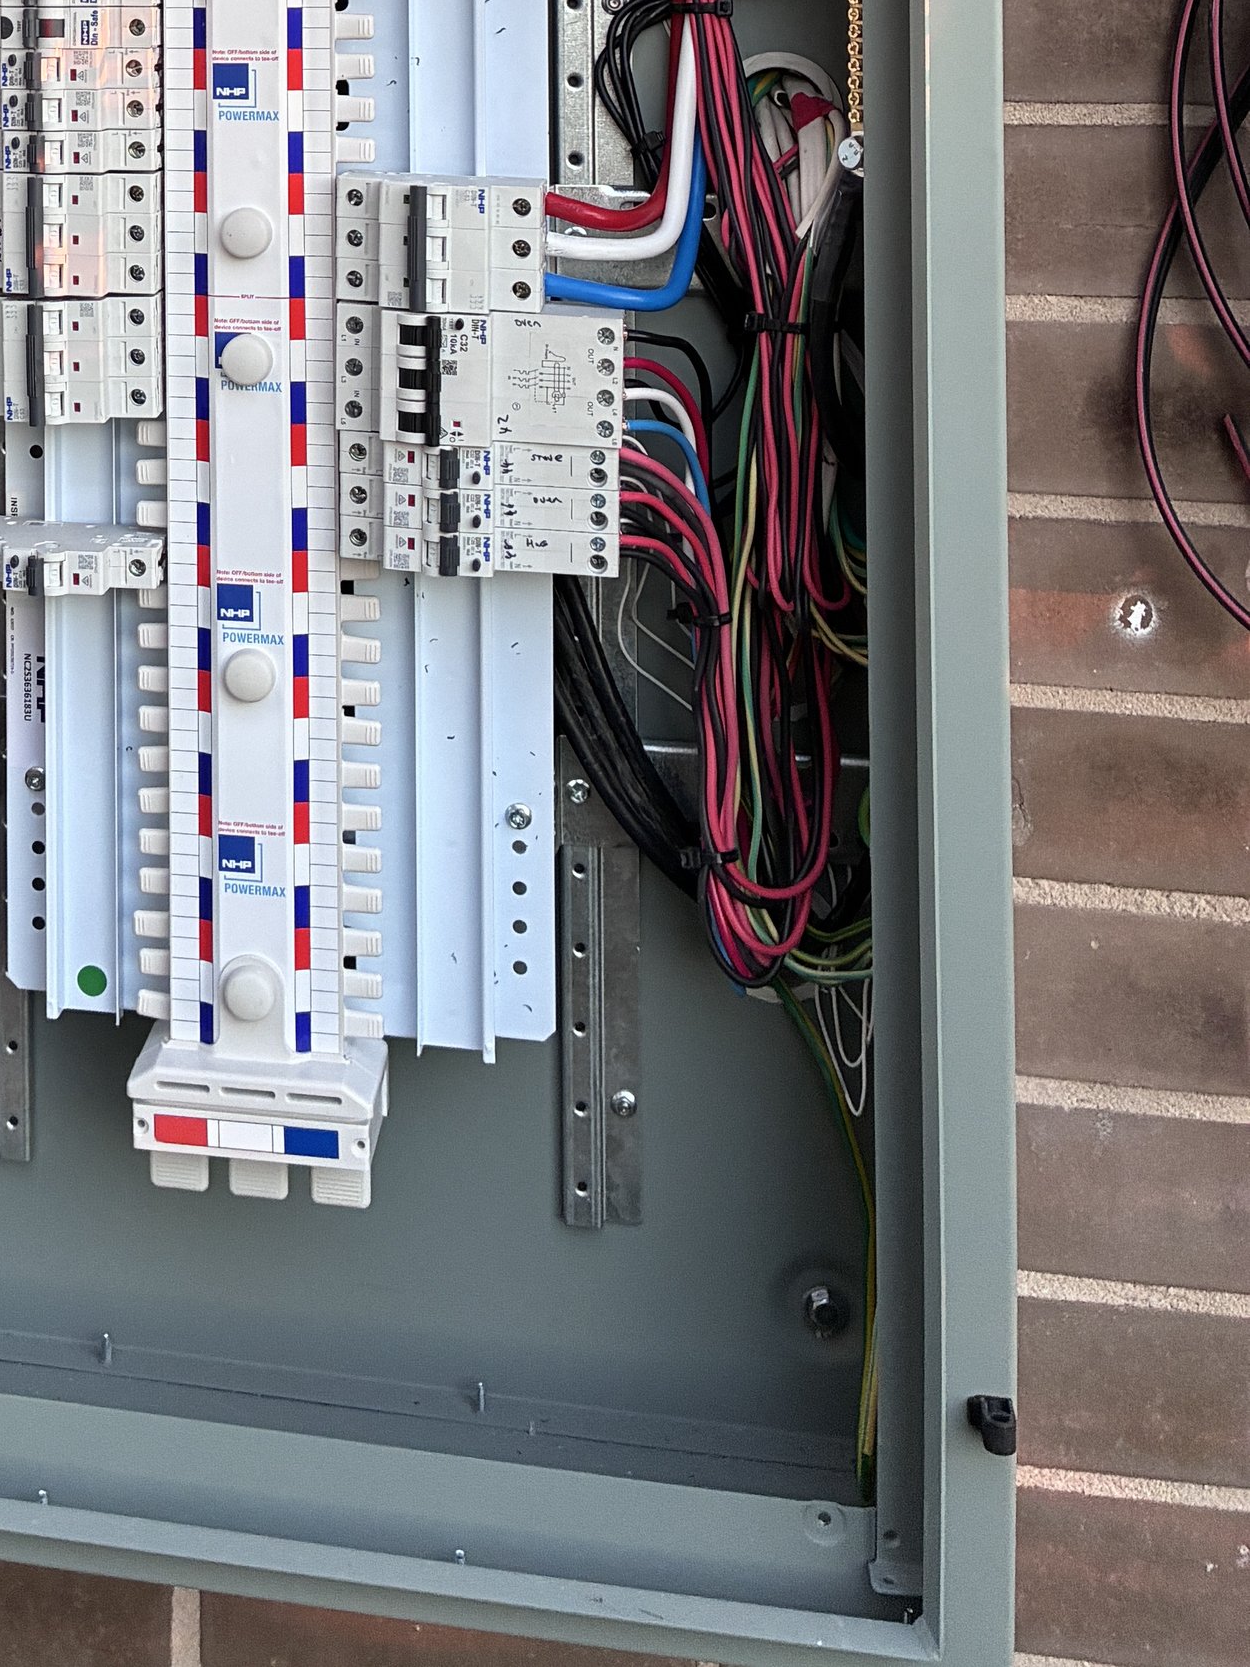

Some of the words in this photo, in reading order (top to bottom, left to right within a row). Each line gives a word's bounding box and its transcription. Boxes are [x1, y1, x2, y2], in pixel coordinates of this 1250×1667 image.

[216, 87, 246, 97] NHP
[218, 110, 280, 121] POWERMAX
[450, 334, 458, 355] 10kA
[459, 334, 468, 353] C32
[483, 450, 491, 475] NHP
[483, 537, 491, 562] NHP
[220, 608, 250, 618] NHP
[222, 632, 284, 645] POWERMAX
[222, 859, 252, 869] NHP
[224, 883, 286, 898] POWERMAX
